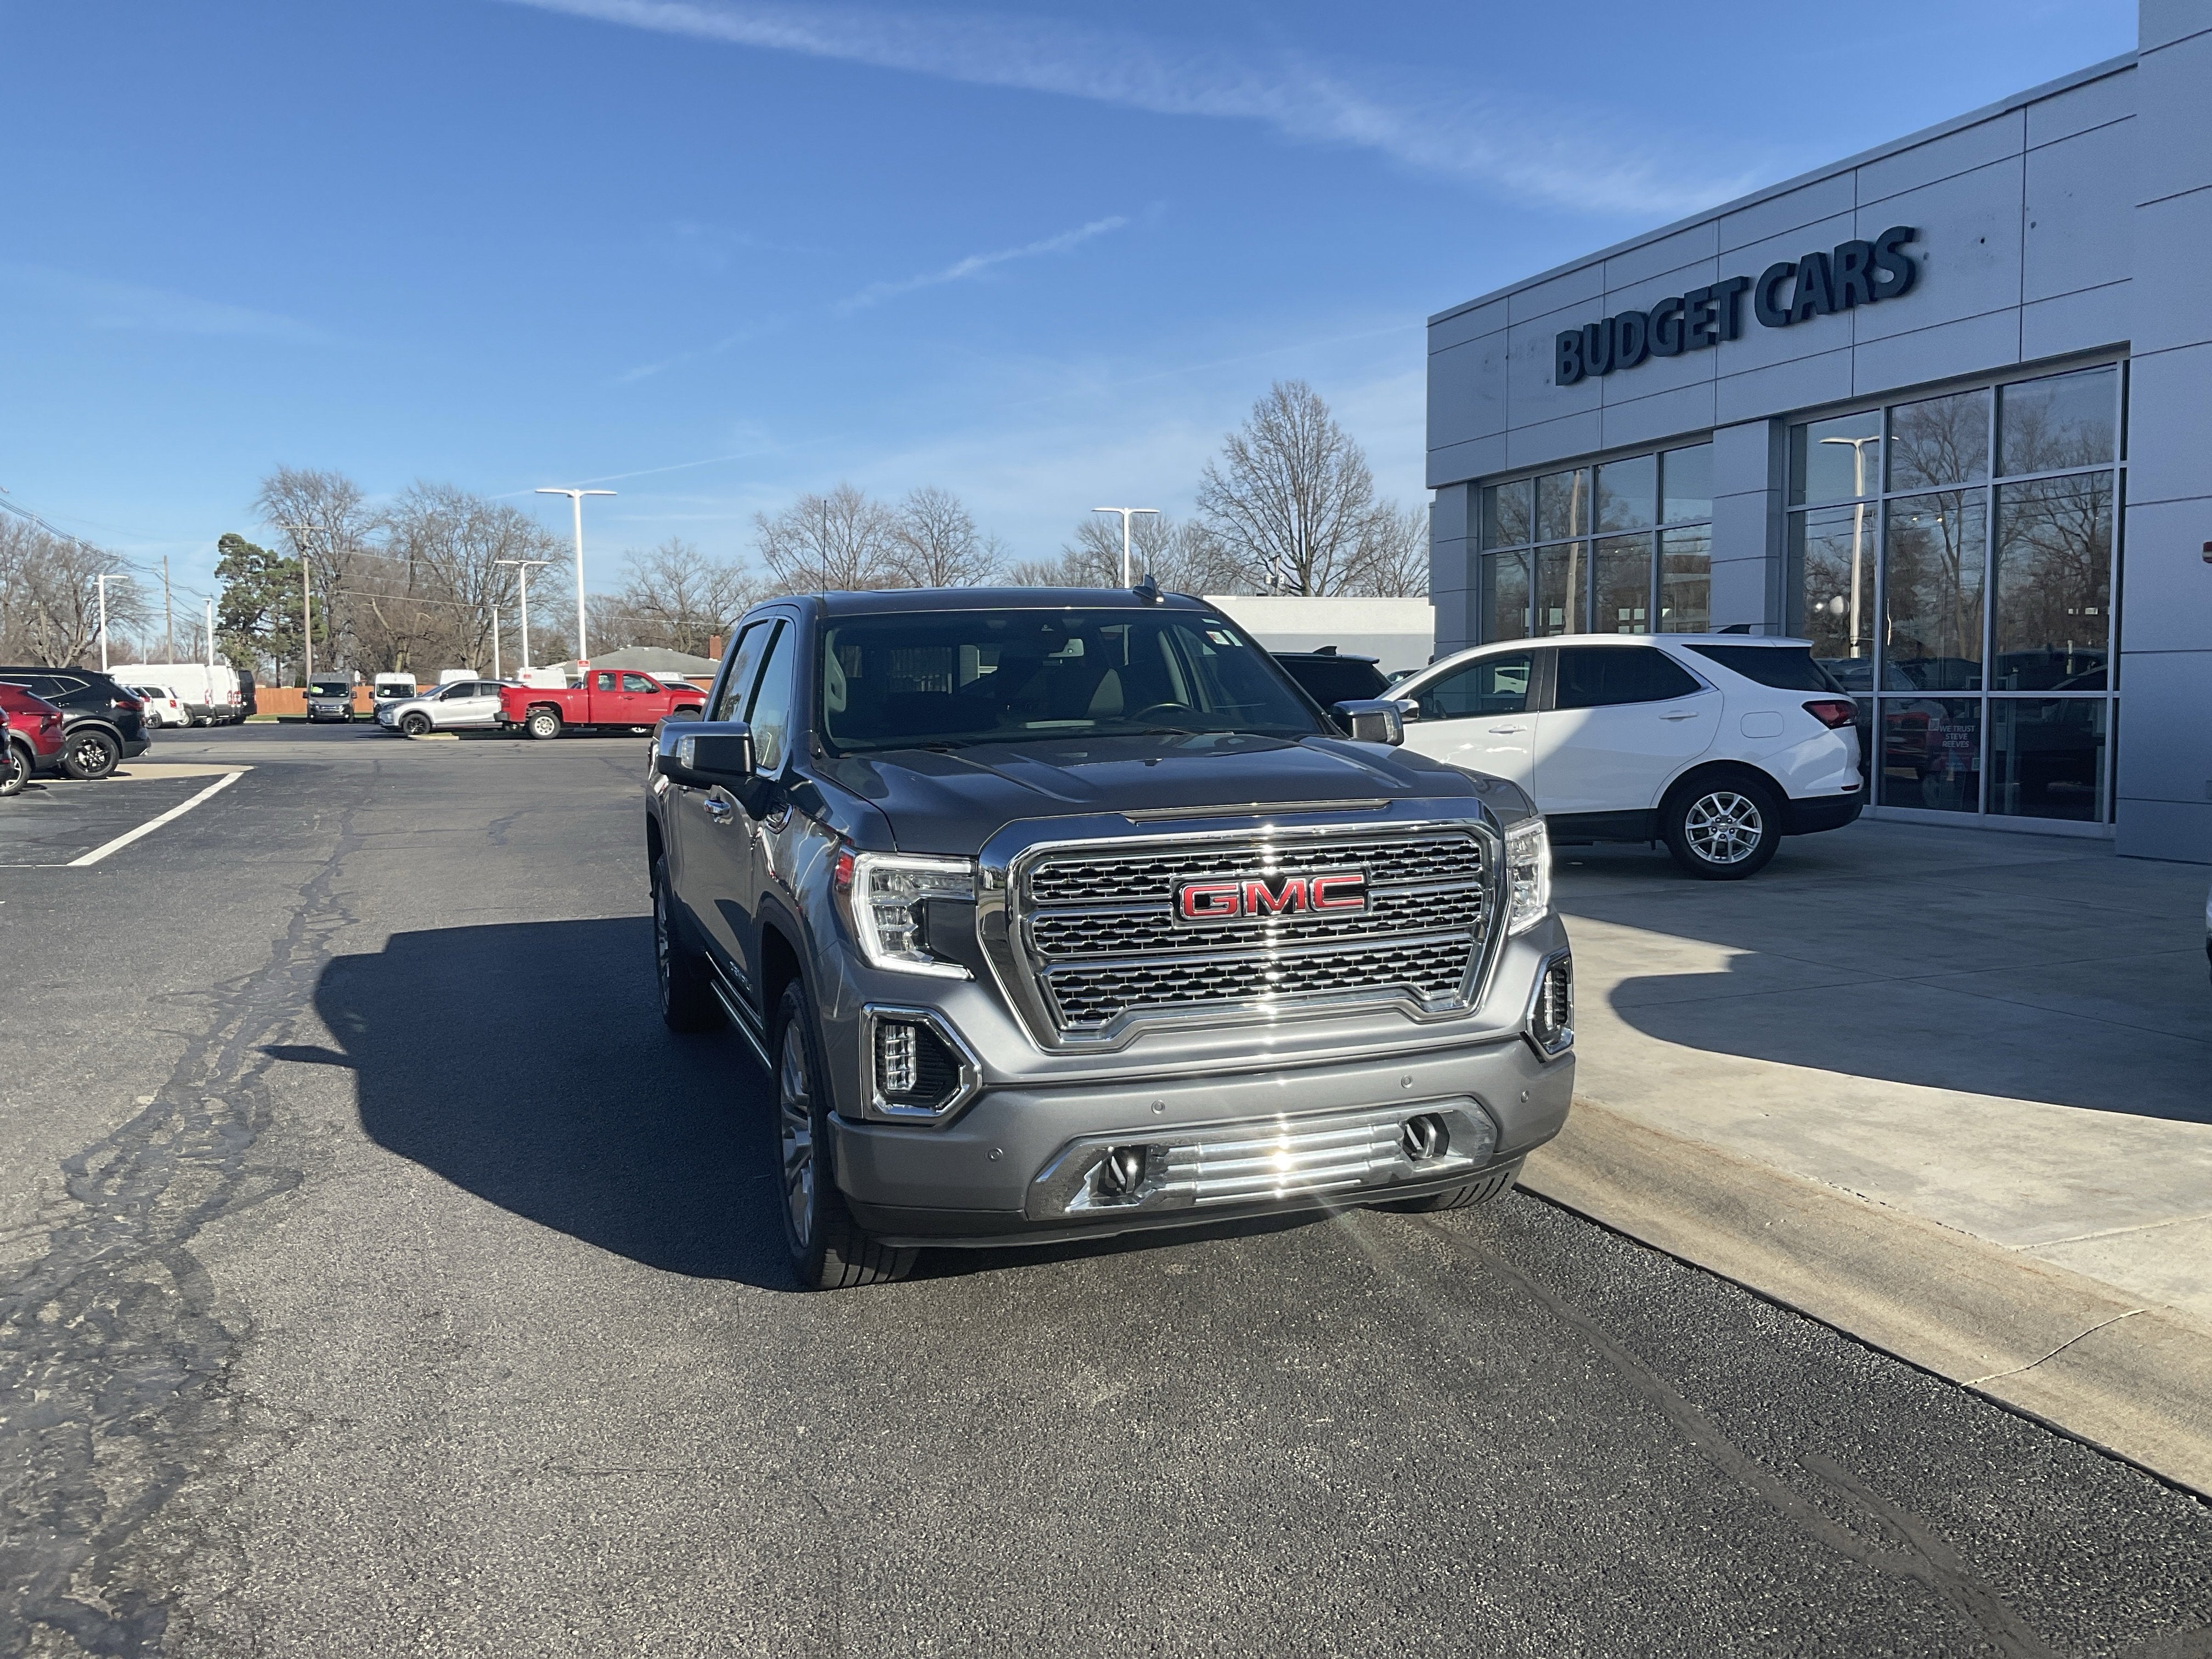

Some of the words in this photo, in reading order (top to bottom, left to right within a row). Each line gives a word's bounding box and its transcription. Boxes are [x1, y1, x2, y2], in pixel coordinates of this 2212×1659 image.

[1555, 276, 1751, 386] BUDGET
[1754, 225, 1916, 328] CARS
[1180, 874, 1364, 920] GMC
